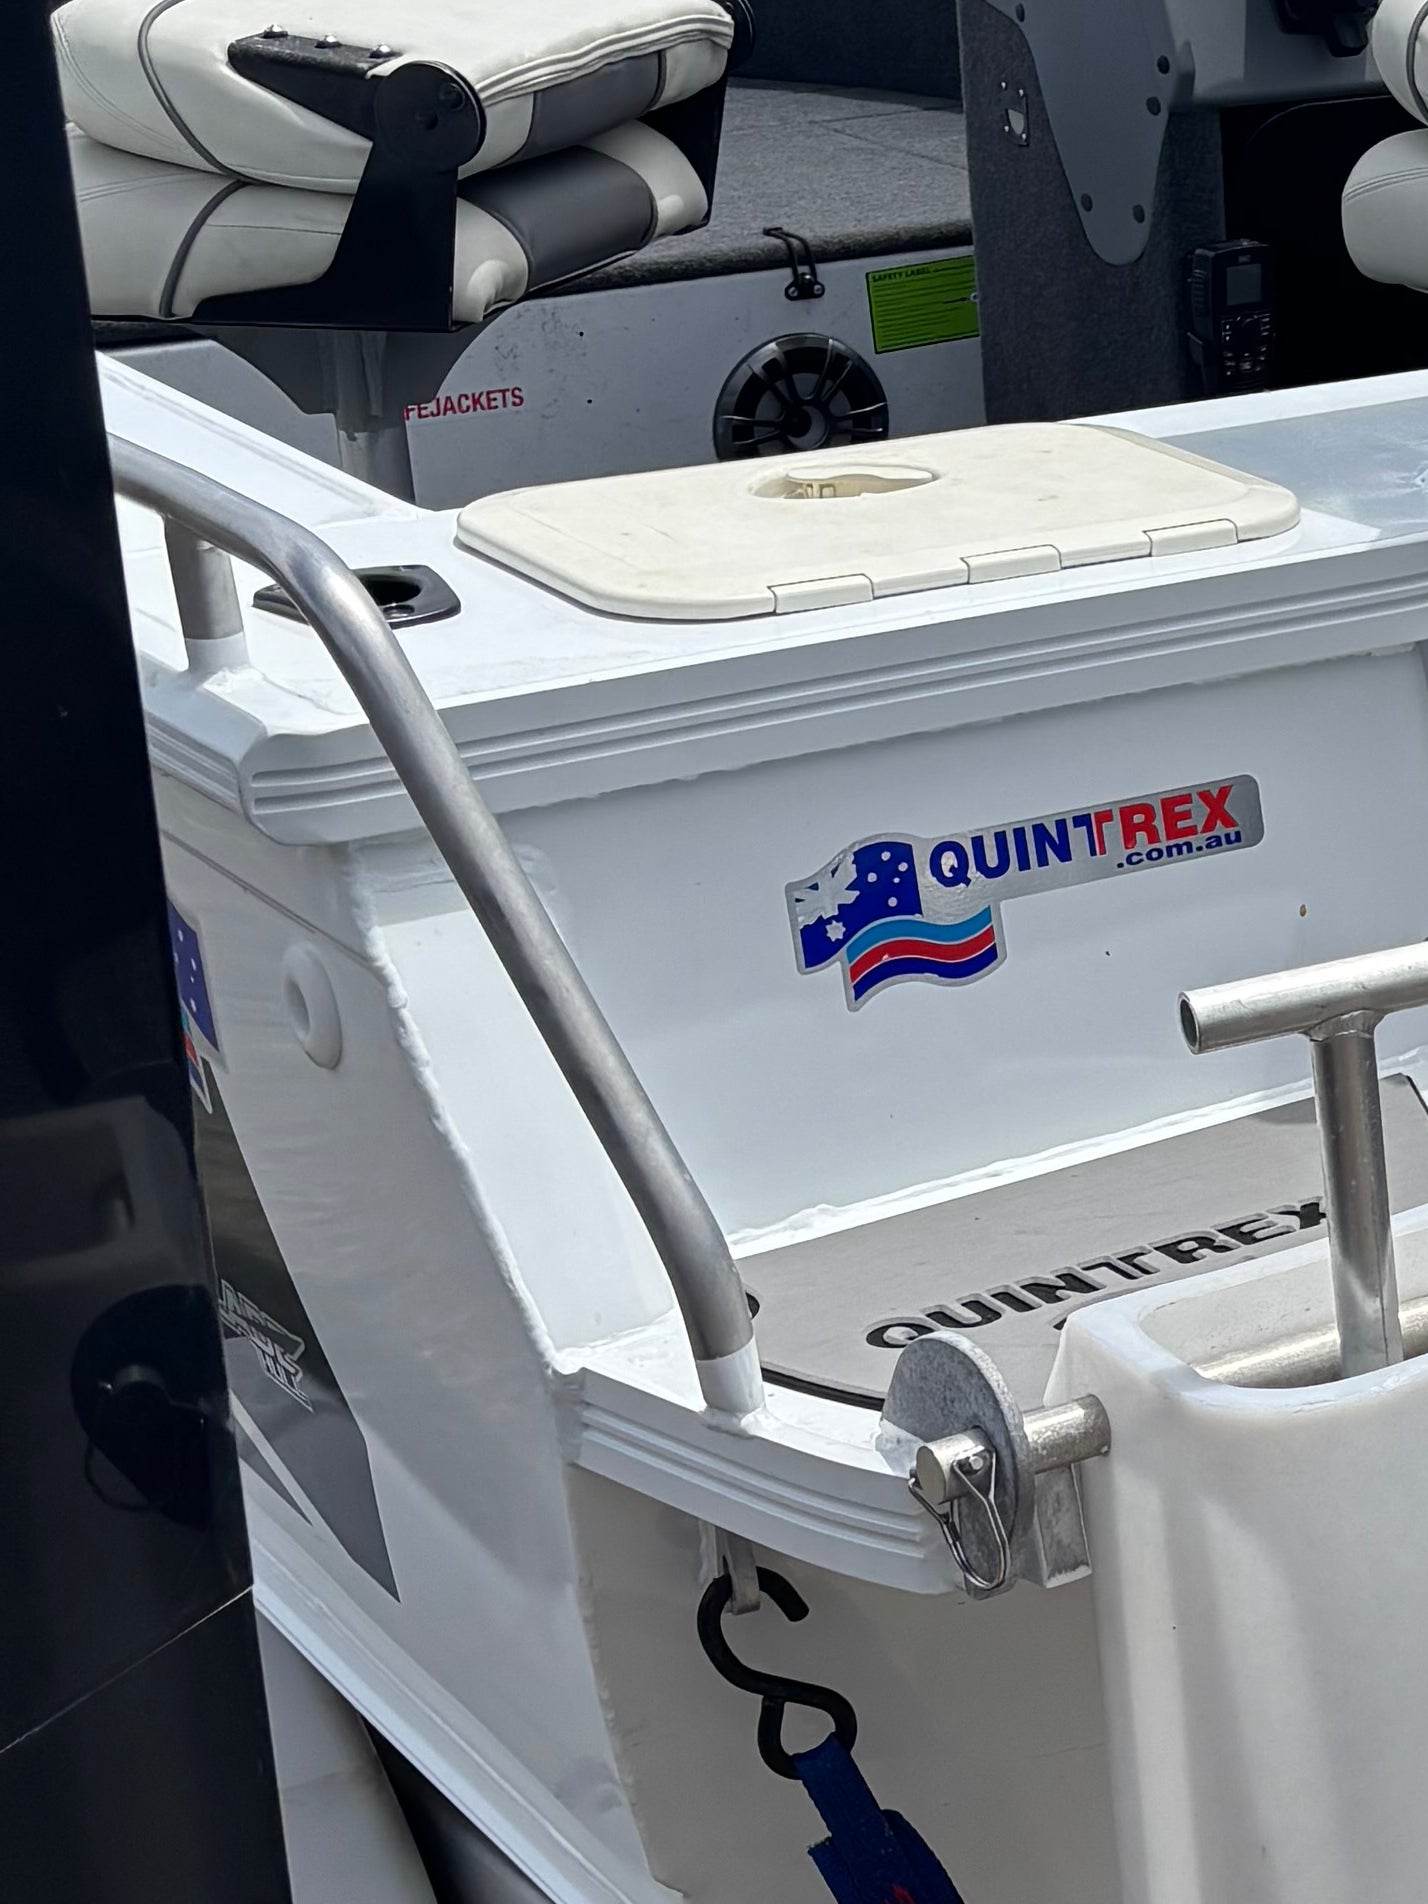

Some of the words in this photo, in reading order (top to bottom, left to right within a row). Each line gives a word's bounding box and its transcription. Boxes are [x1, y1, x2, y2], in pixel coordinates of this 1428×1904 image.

[403, 386, 525, 421] FEJACKETS
[929, 783, 1240, 887] QUINTREX
[1116, 830, 1243, 870] .com.au
